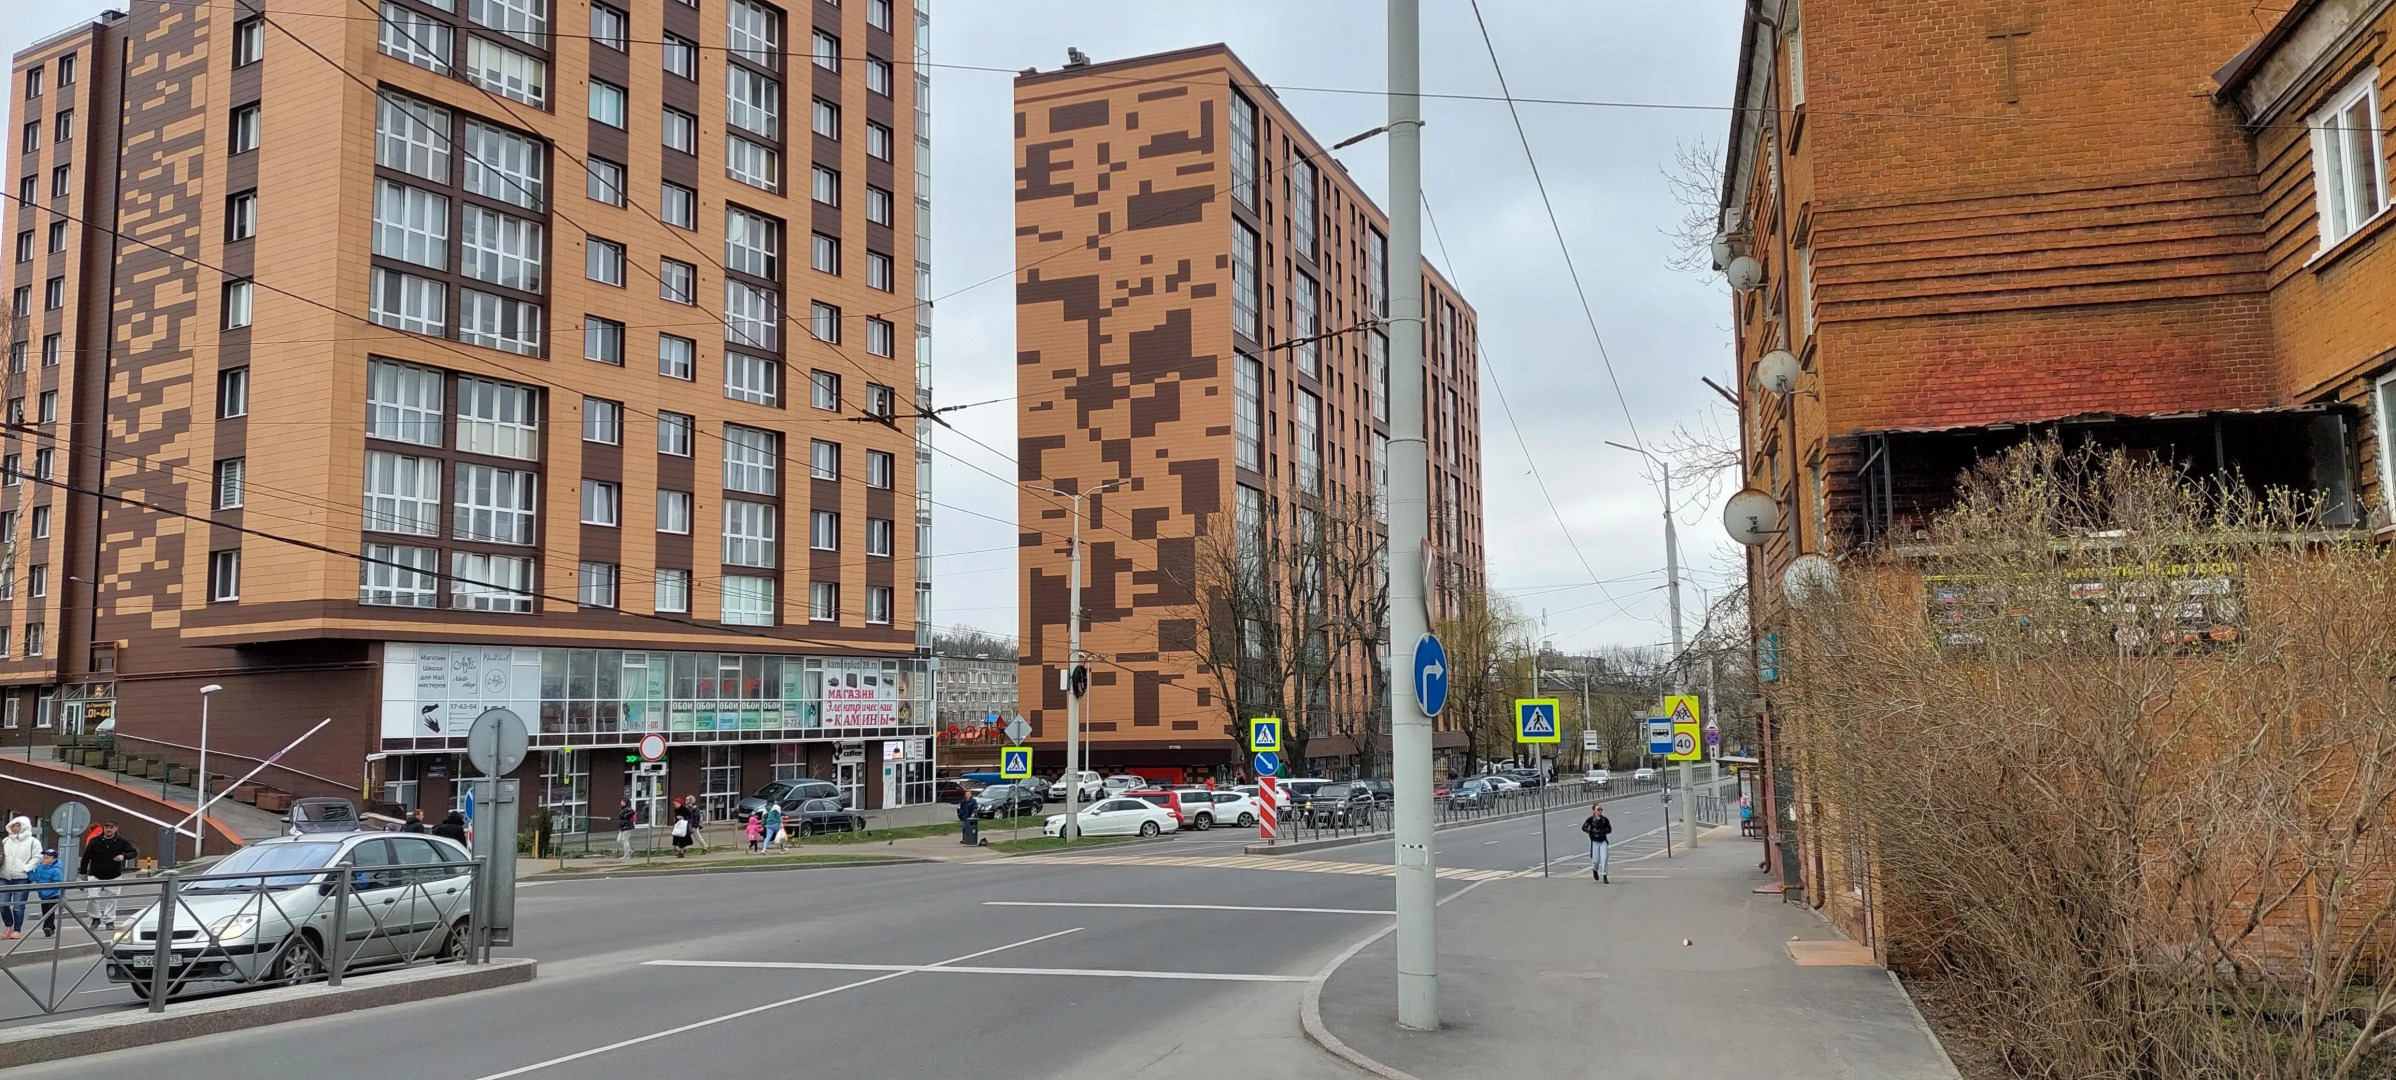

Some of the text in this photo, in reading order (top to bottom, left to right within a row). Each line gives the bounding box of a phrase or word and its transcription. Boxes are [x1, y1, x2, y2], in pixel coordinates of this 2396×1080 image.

[420, 654, 446, 662] Магазин
[828, 689, 875, 699] МАГАЗИН
[672, 701, 693, 711] ОБОИ
[696, 701, 717, 710] ОБОИ
[719, 701, 739, 710] ОБОИ
[741, 701, 760, 710] ОБОИ
[763, 701, 781, 710] ОБОИ
[826, 700, 894, 713] Электрические
[834, 714, 890, 726] КАМИНЫ
[843, 742, 864, 750] cosmic
[1676, 739, 1692, 749] 40
